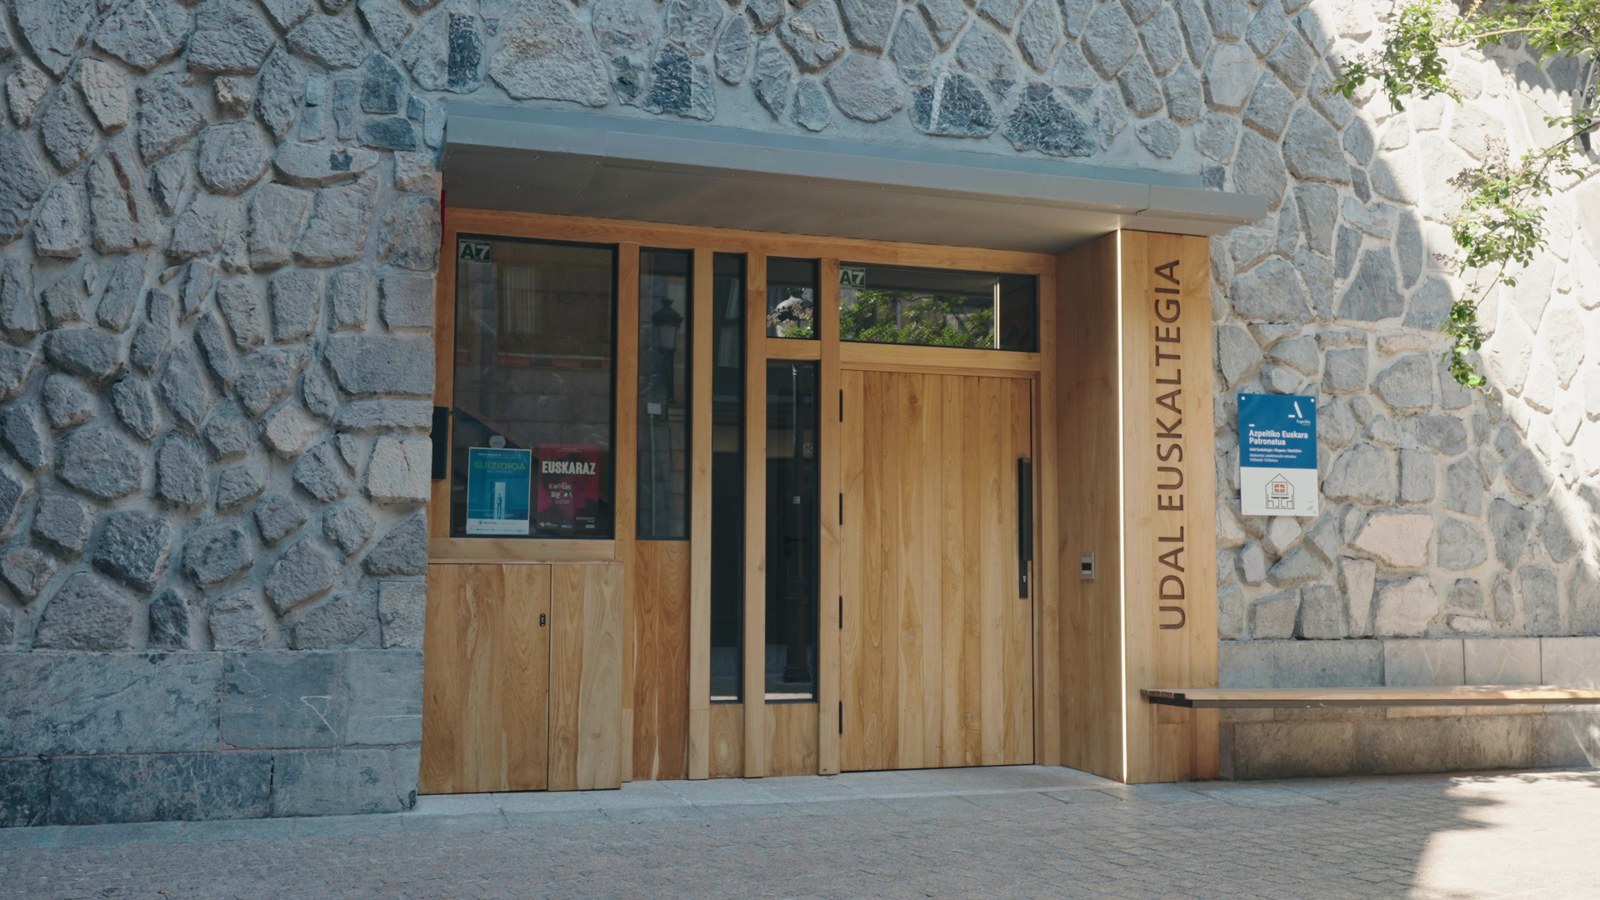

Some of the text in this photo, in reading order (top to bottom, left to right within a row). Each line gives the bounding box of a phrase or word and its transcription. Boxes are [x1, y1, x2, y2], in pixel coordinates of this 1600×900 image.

[460, 244, 490, 260] A7
[840, 270, 864, 285] A7
[1249, 429, 1308, 439] Azpeitiko Euskara
[1249, 437, 1286, 446] Patronatua
[1154, 259, 1186, 630] UDAL EUSKALTEGIA
[541, 460, 596, 475] EUSKARAZ
